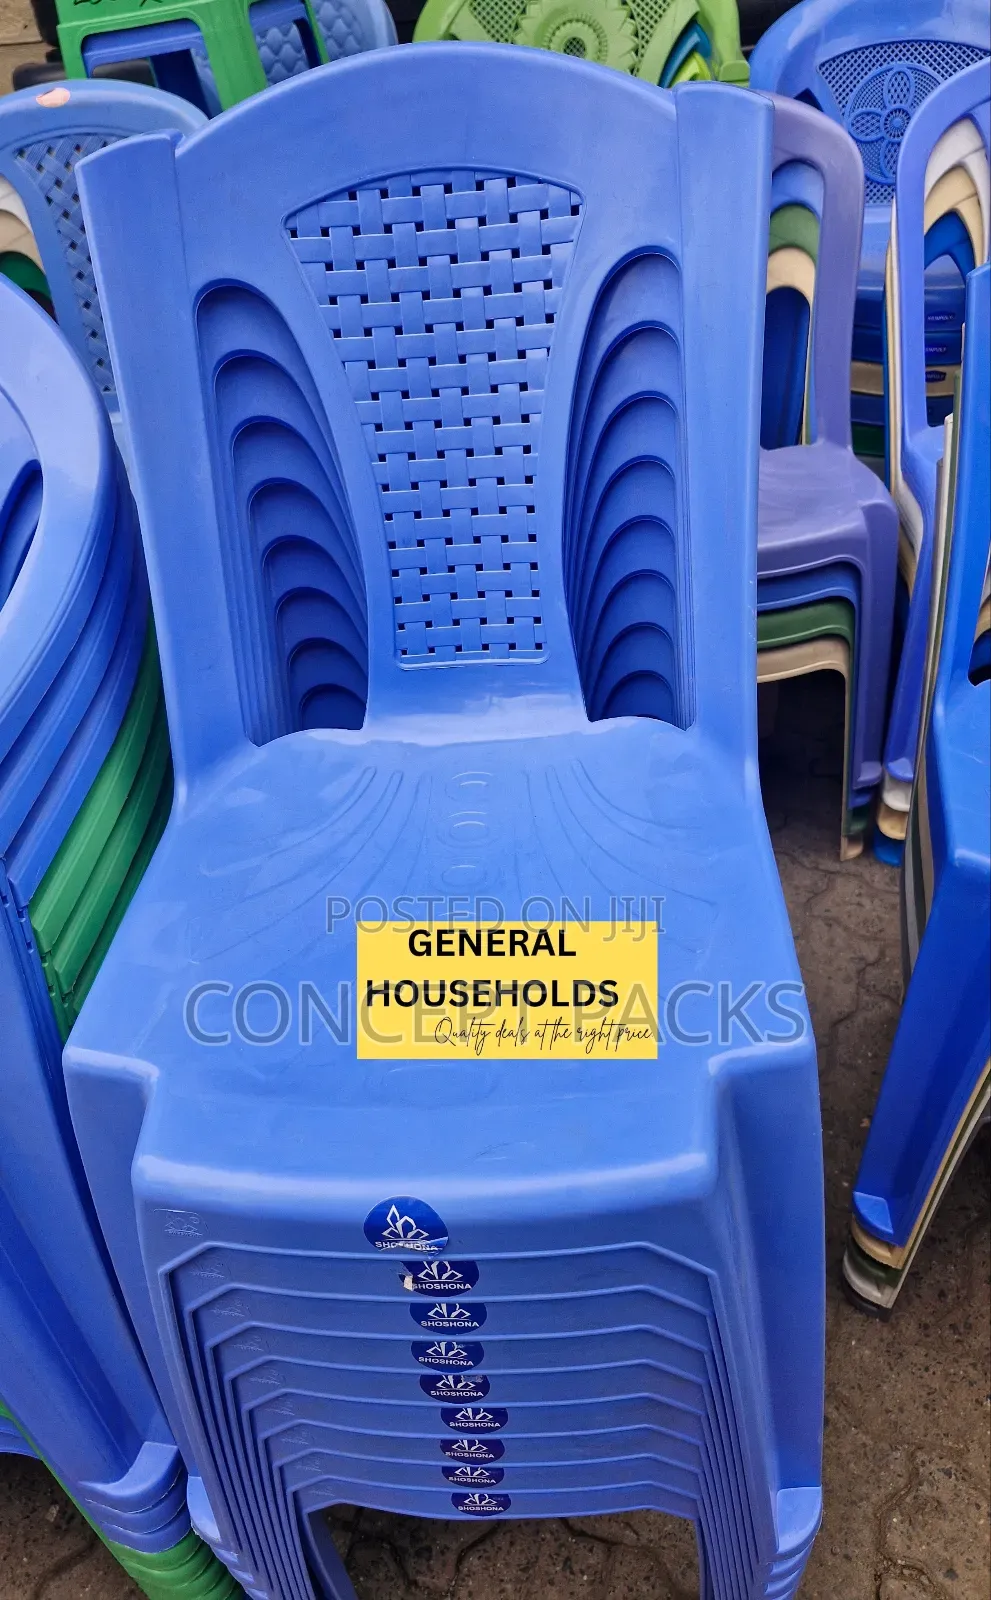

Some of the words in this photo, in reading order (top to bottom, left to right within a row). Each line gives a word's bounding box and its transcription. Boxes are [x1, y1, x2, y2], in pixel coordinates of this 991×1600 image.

[420, 1320, 480, 1328] SHOSHONA
[418, 1356, 474, 1366] SHOSHONA
[445, 1451, 495, 1459] SHOSHONA
[448, 1476, 497, 1484] SHOSHONA
